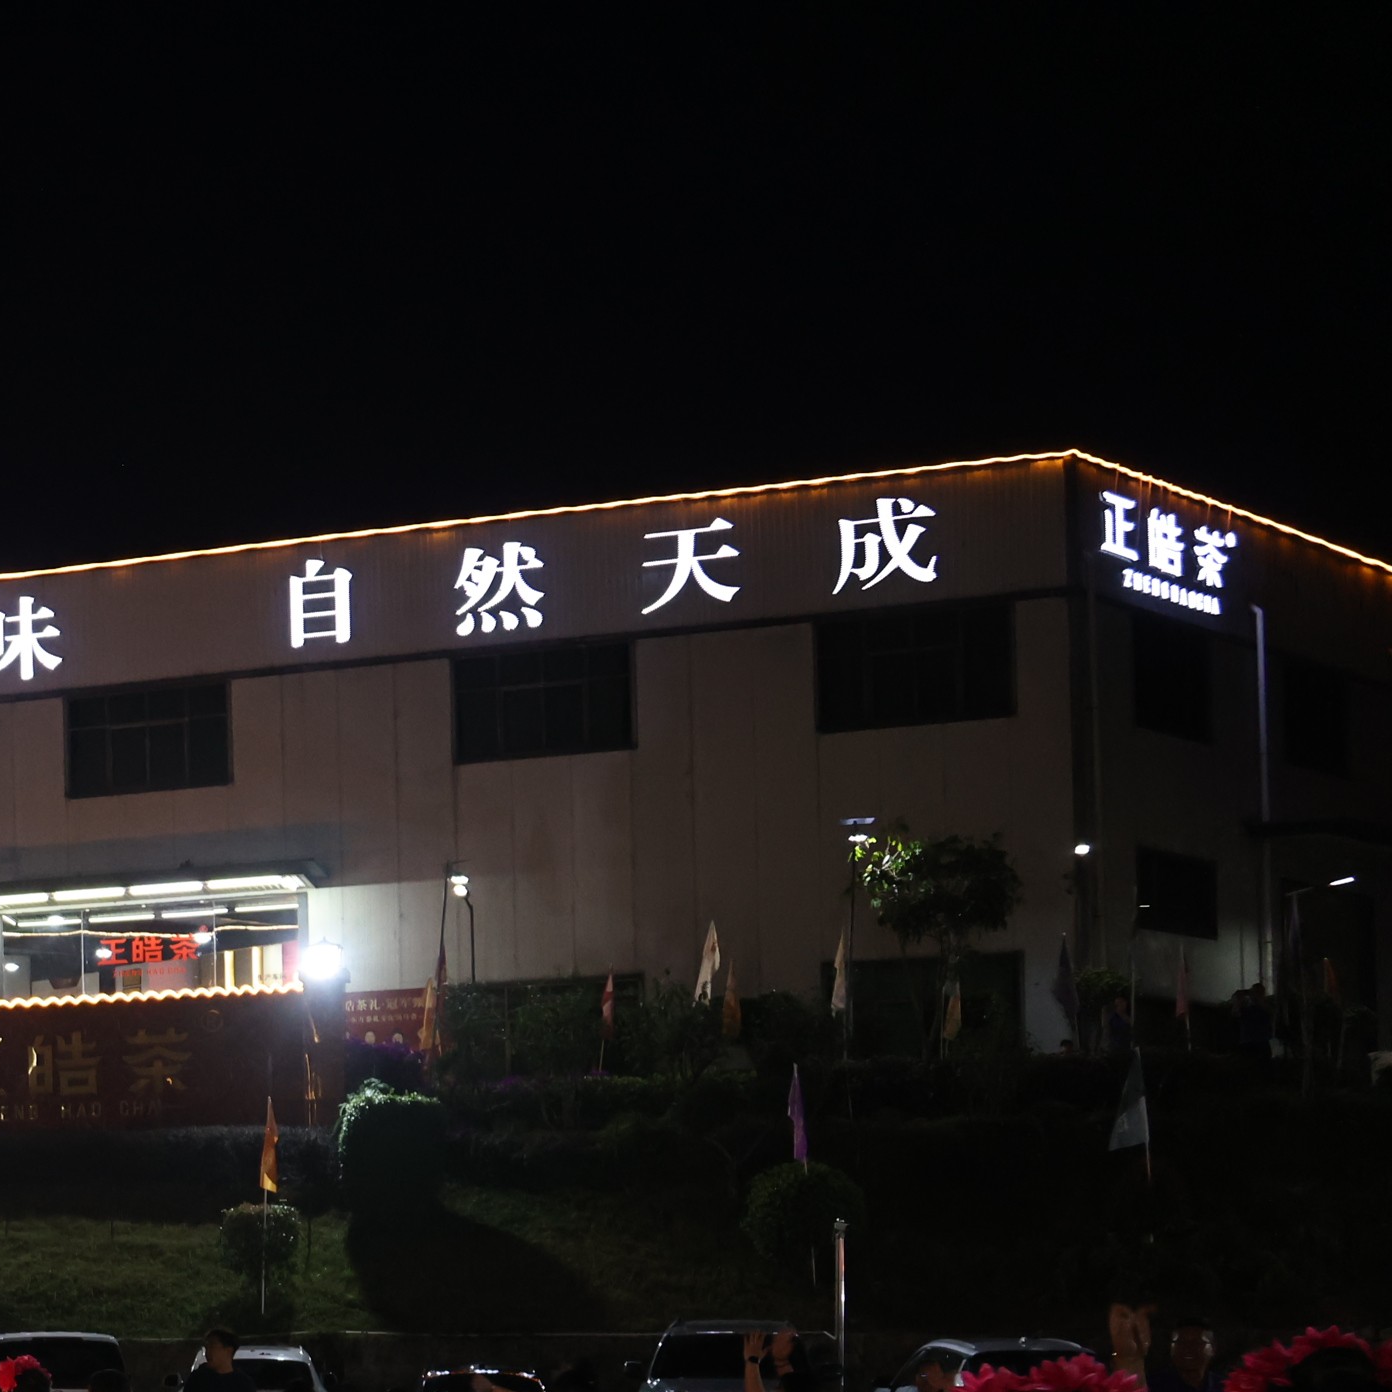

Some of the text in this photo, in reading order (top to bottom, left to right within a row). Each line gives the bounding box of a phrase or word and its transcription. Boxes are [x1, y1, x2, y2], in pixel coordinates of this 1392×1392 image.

[288, 497, 937, 650] 自然天成
[1100, 491, 1228, 588] 正皓茶
[97, 932, 201, 967] 正皓茶
